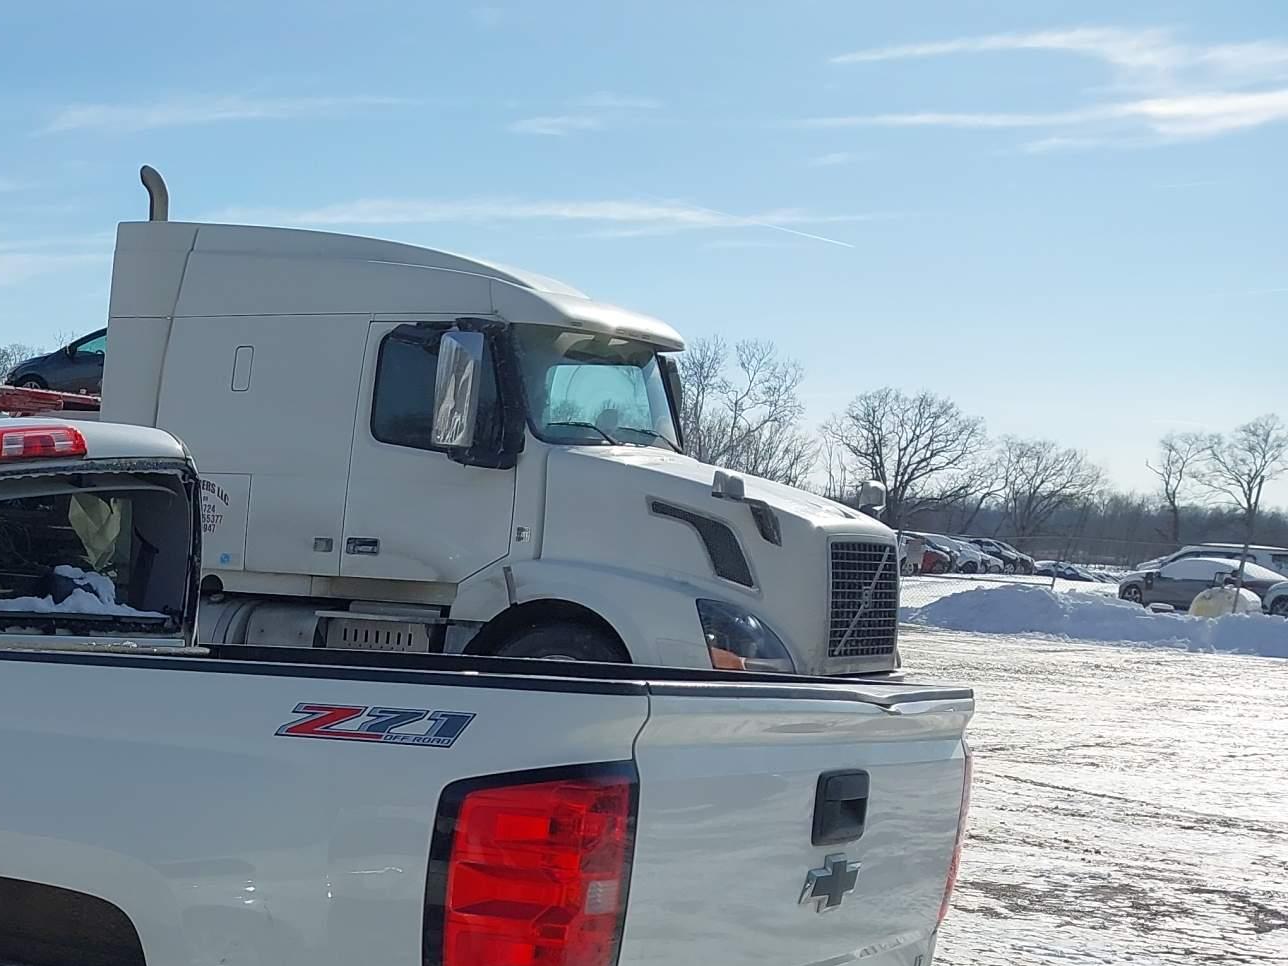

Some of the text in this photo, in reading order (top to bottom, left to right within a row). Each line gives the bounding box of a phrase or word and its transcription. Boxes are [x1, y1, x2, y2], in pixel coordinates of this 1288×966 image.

[201, 480, 230, 506] ERS LLC
[203, 504, 216, 513] 724
[202, 514, 223, 524] 55377
[203, 524, 216, 533] 947
[275, 703, 476, 744] Z71
[383, 734, 452, 745] OFF ROAD
